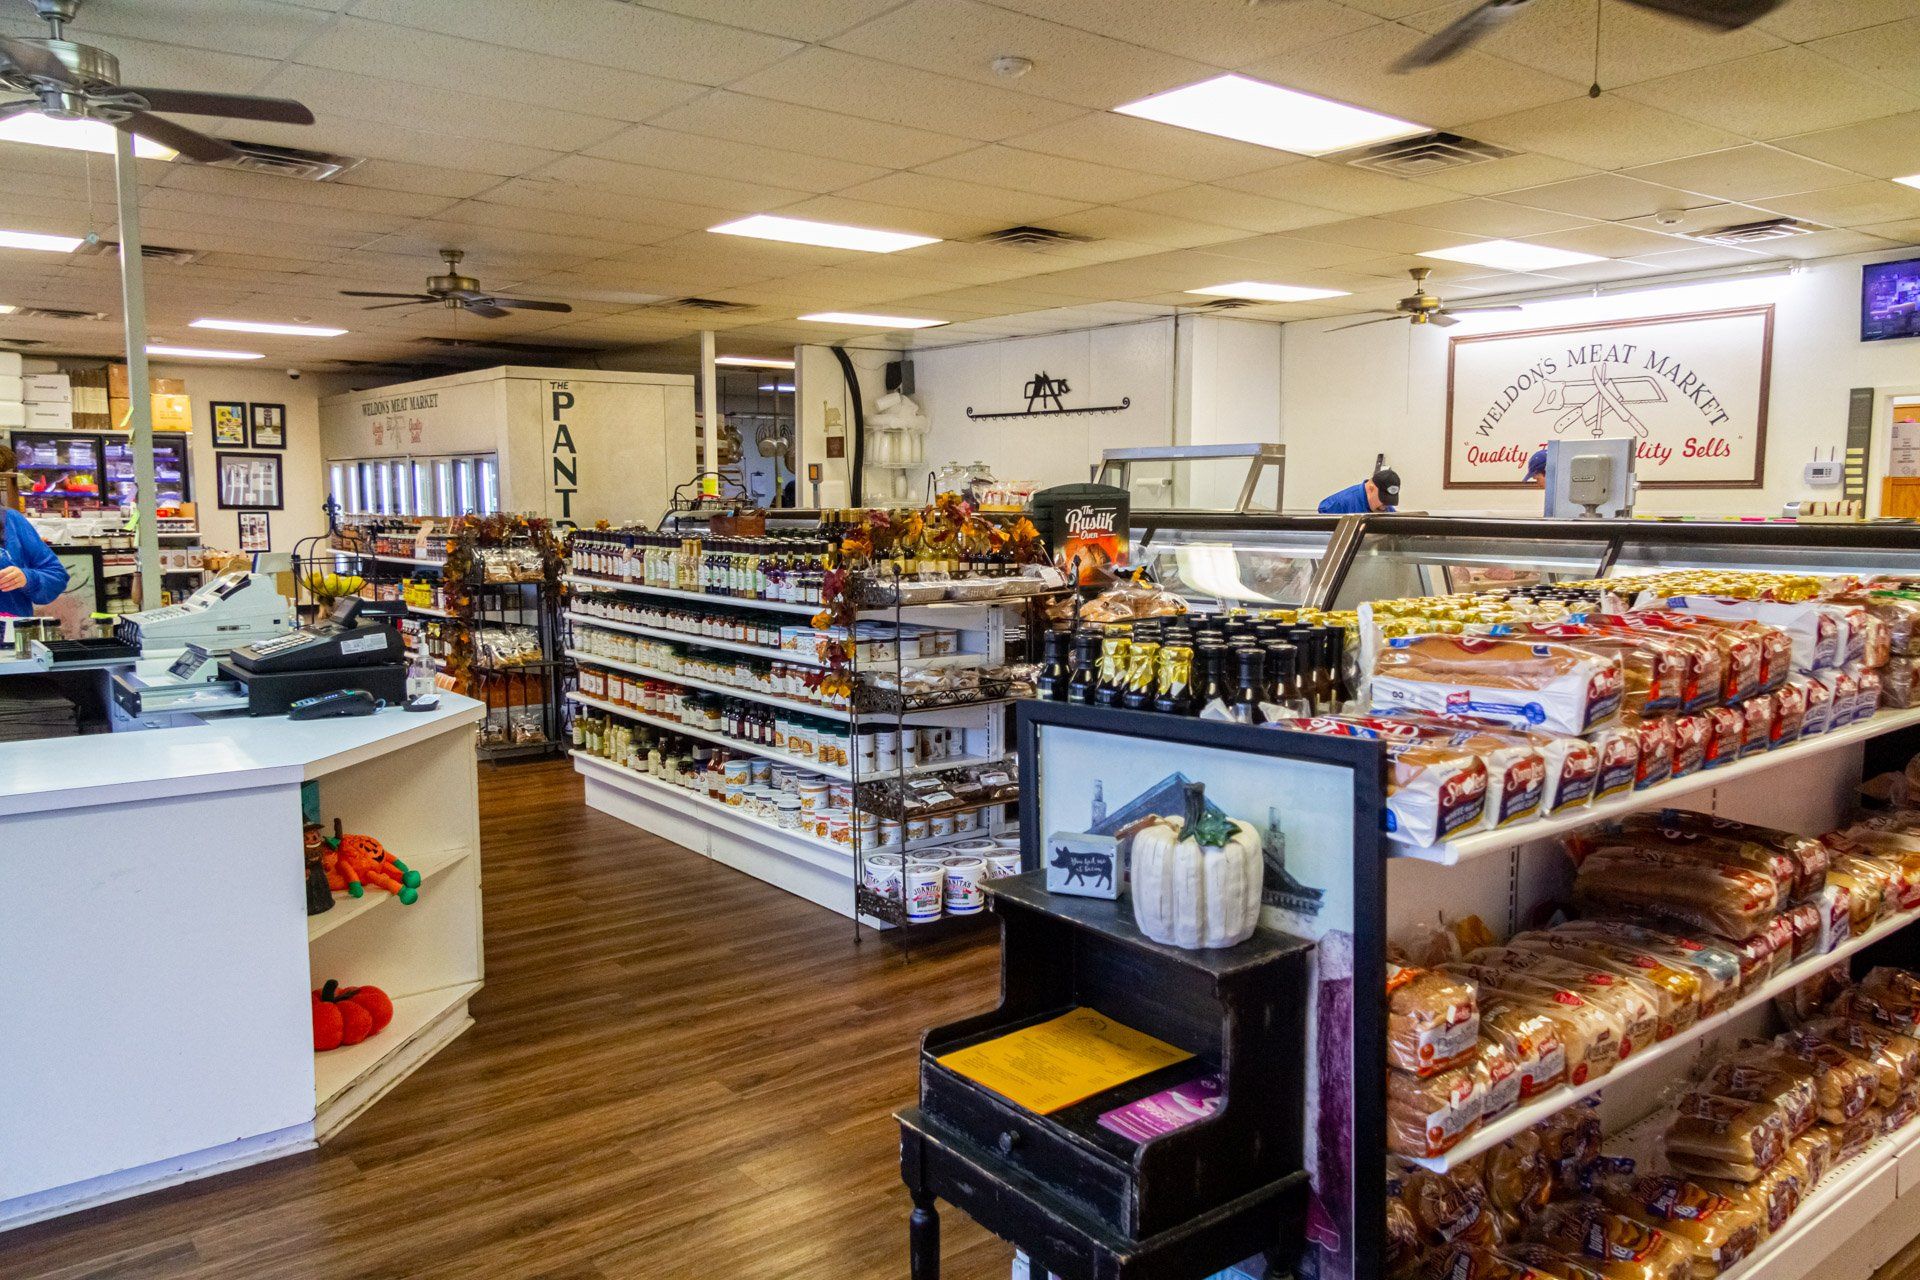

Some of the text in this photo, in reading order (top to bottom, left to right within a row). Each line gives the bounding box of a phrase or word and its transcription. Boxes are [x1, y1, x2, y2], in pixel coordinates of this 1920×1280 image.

[550, 381, 569, 390] THE
[1476, 344, 1729, 439] WELDON'S MEAT MARKET
[391, 397, 408, 413] MEAT
[410, 393, 439, 411] MARKET
[1081, 505, 1094, 515] The
[1065, 508, 1118, 534] Rustik
[1080, 530, 1099, 540] Oven
